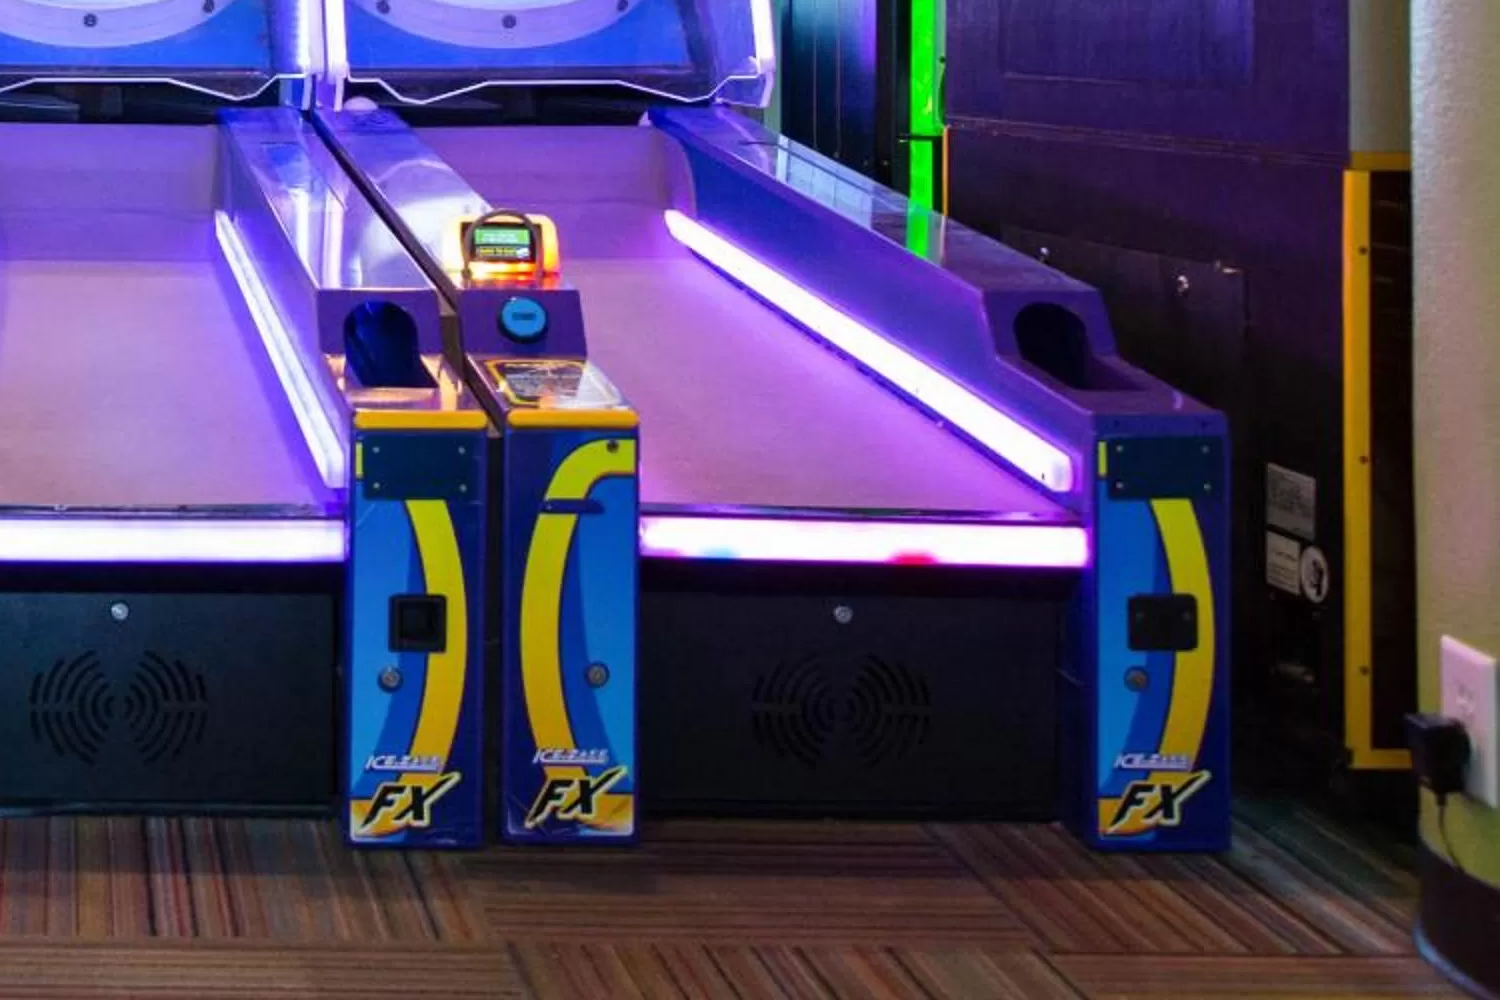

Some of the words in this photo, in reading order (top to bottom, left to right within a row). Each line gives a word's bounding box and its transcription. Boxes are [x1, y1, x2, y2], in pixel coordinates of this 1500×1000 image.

[358, 771, 461, 835] FX
[524, 765, 628, 829] FX
[1105, 770, 1213, 835] FX
